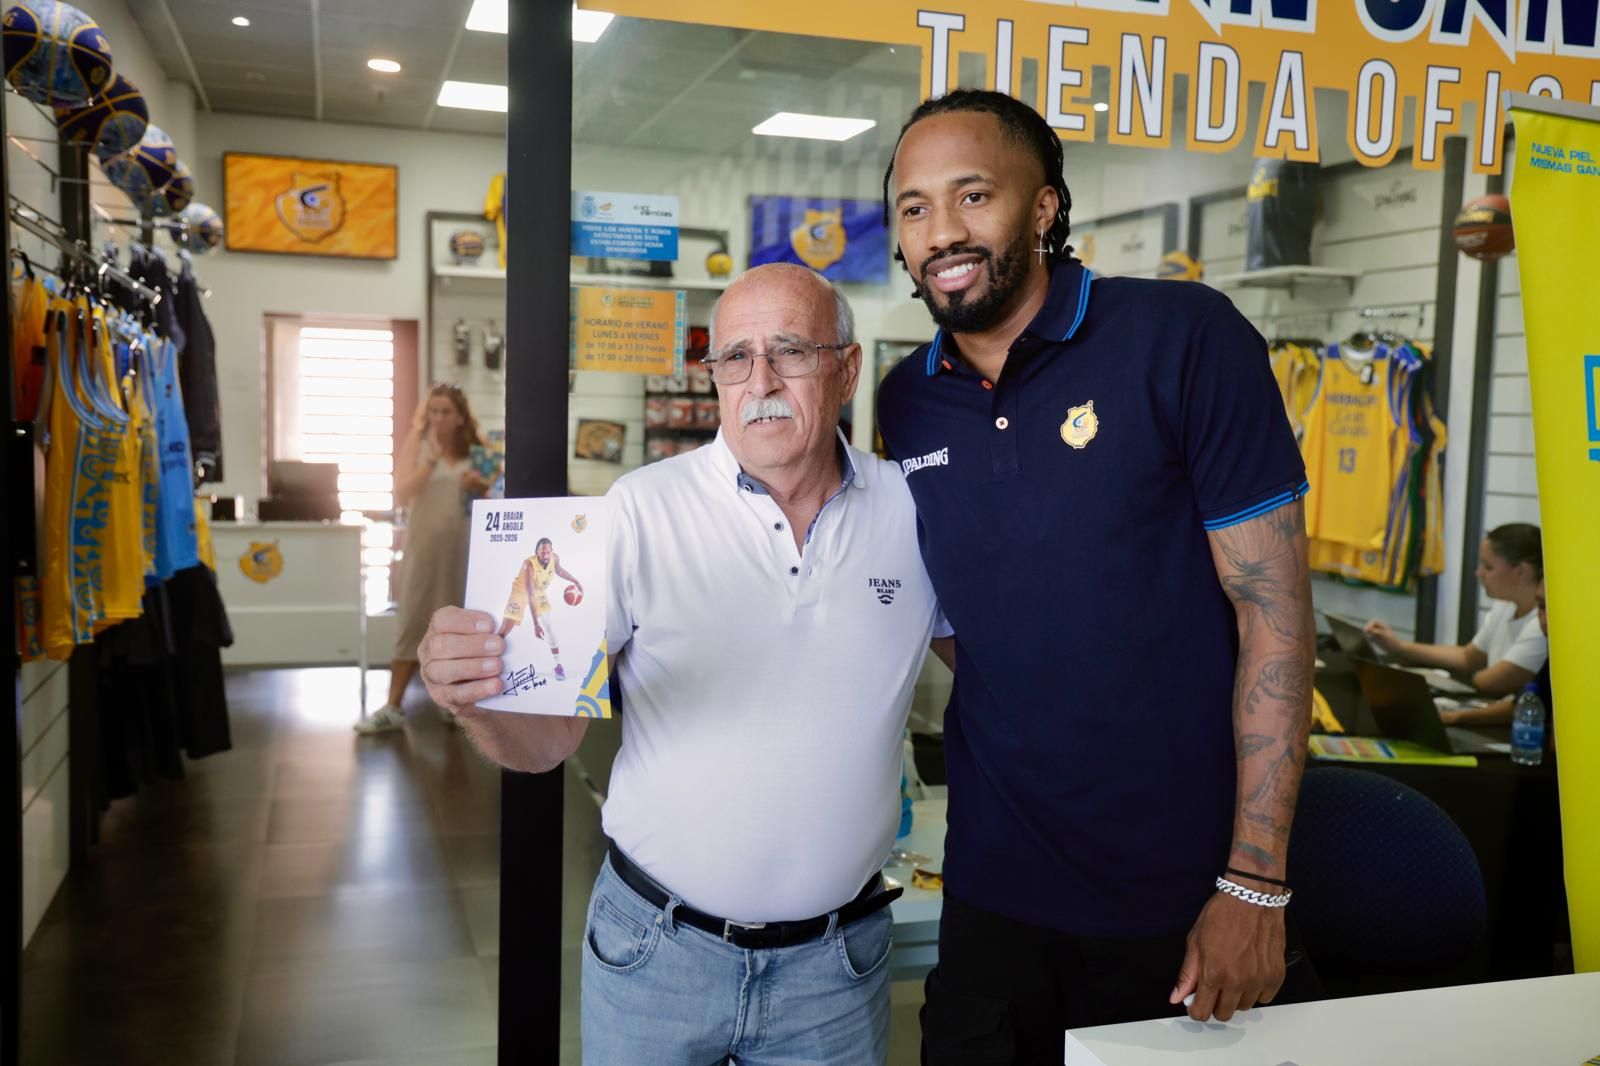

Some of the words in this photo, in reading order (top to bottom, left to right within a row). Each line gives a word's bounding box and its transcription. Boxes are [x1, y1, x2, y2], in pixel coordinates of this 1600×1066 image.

[917, 11, 1310, 151] TIENDA
[1531, 142, 1565, 158] NUEVA
[1569, 150, 1596, 163] PIEL
[1530, 156, 1572, 173] MISMAS
[583, 318, 622, 328] HORARIO
[624, 320, 633, 328] de
[635, 320, 669, 330] VERANO
[592, 330, 618, 339] LUNES
[627, 332, 660, 341] VIERNES
[485, 511, 500, 532] 24
[503, 511, 524, 521] BRAIAN
[502, 521, 524, 531] ANGOLA
[869, 578, 902, 589] JEANS
